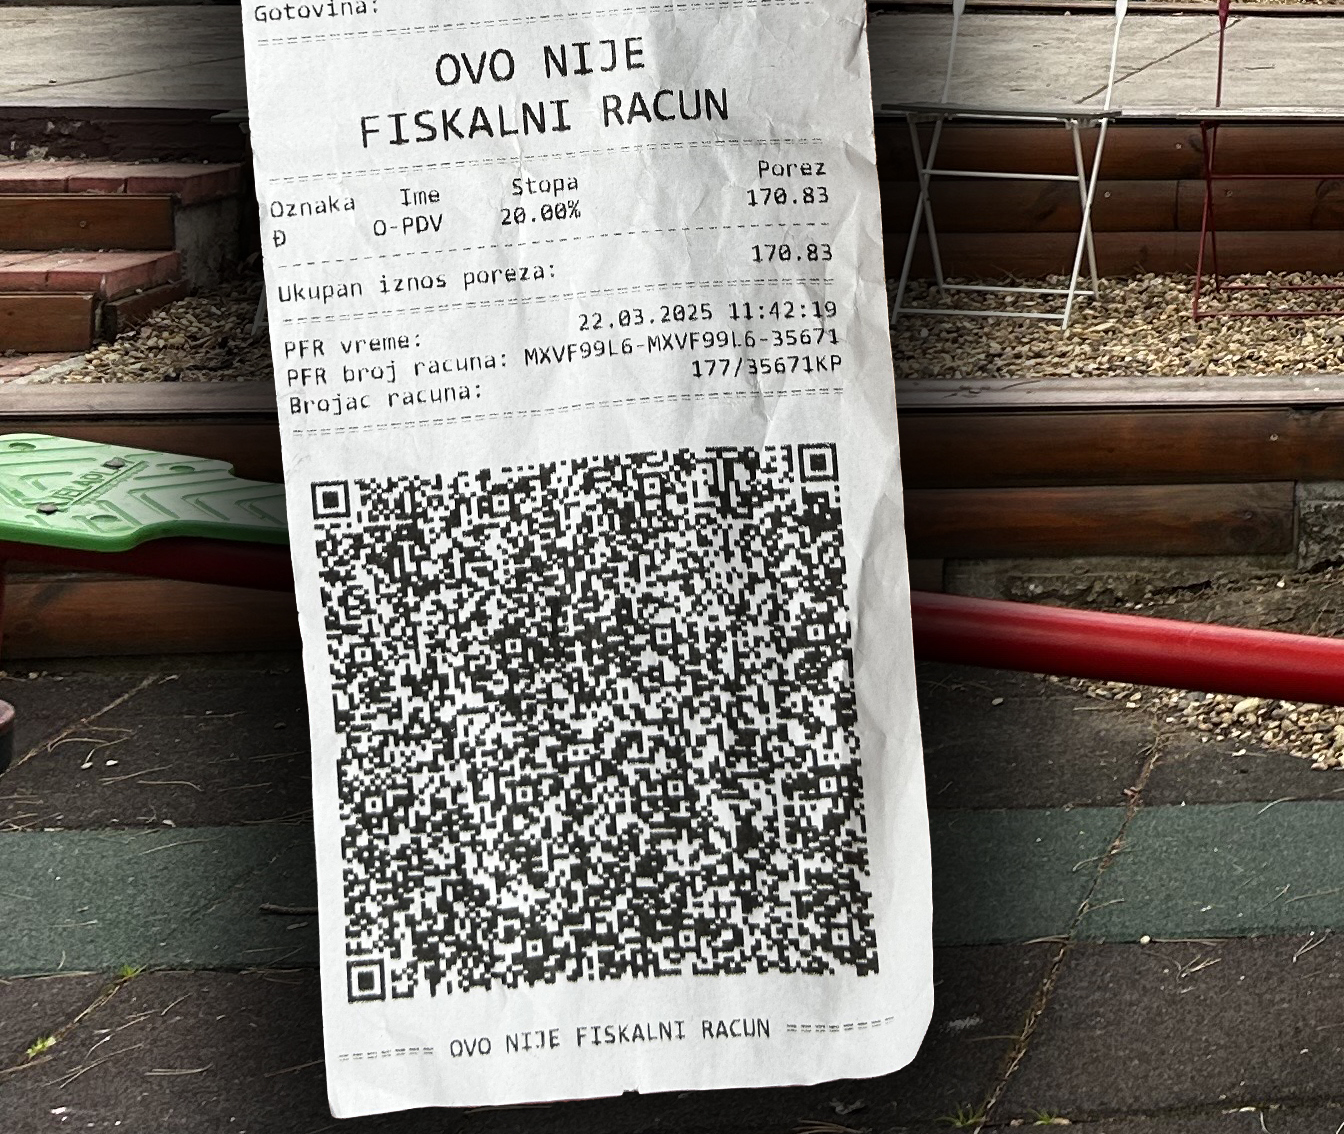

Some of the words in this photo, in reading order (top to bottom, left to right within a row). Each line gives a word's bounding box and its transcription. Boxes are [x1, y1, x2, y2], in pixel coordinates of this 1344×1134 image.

[435, 47, 516, 88] OVO
[543, 36, 646, 80] NIJE
[360, 98, 572, 149] FISKALNI
[602, 85, 729, 128] RACUN
[270, 194, 356, 219] Oznaka
[399, 187, 441, 207] Ime
[511, 174, 579, 198] Stopa
[758, 159, 827, 180] Porez
[373, 213, 443, 237] O-PDV
[499, 199, 582, 227] 20.00%
[746, 186, 829, 208] 170.83
[277, 282, 363, 305] Ukupan
[379, 273, 448, 296] iznos
[463, 264, 555, 292] poreza:
[751, 242, 833, 264] 170.83
[284, 338, 325, 360] PFR
[339, 333, 421, 355] vreme:
[578, 302, 713, 332] 22.03.2025
[728, 299, 839, 323] 11:42:19
[287, 366, 328, 388] PFR
[342, 359, 396, 384] broj
[413, 353, 507, 377] racuna:
[524, 327, 840, 368] MXVF99L6-MXVF99L6-35671
[289, 392, 371, 416] Brojac
[387, 384, 481, 408] racuna:
[690, 353, 844, 380] 177/35671KP
[449, 1036, 492, 1059] OVO
[505, 1027, 561, 1055] NIJE
[576, 1019, 686, 1048] FISKALNI
[701, 1017, 771, 1040] RACUN
